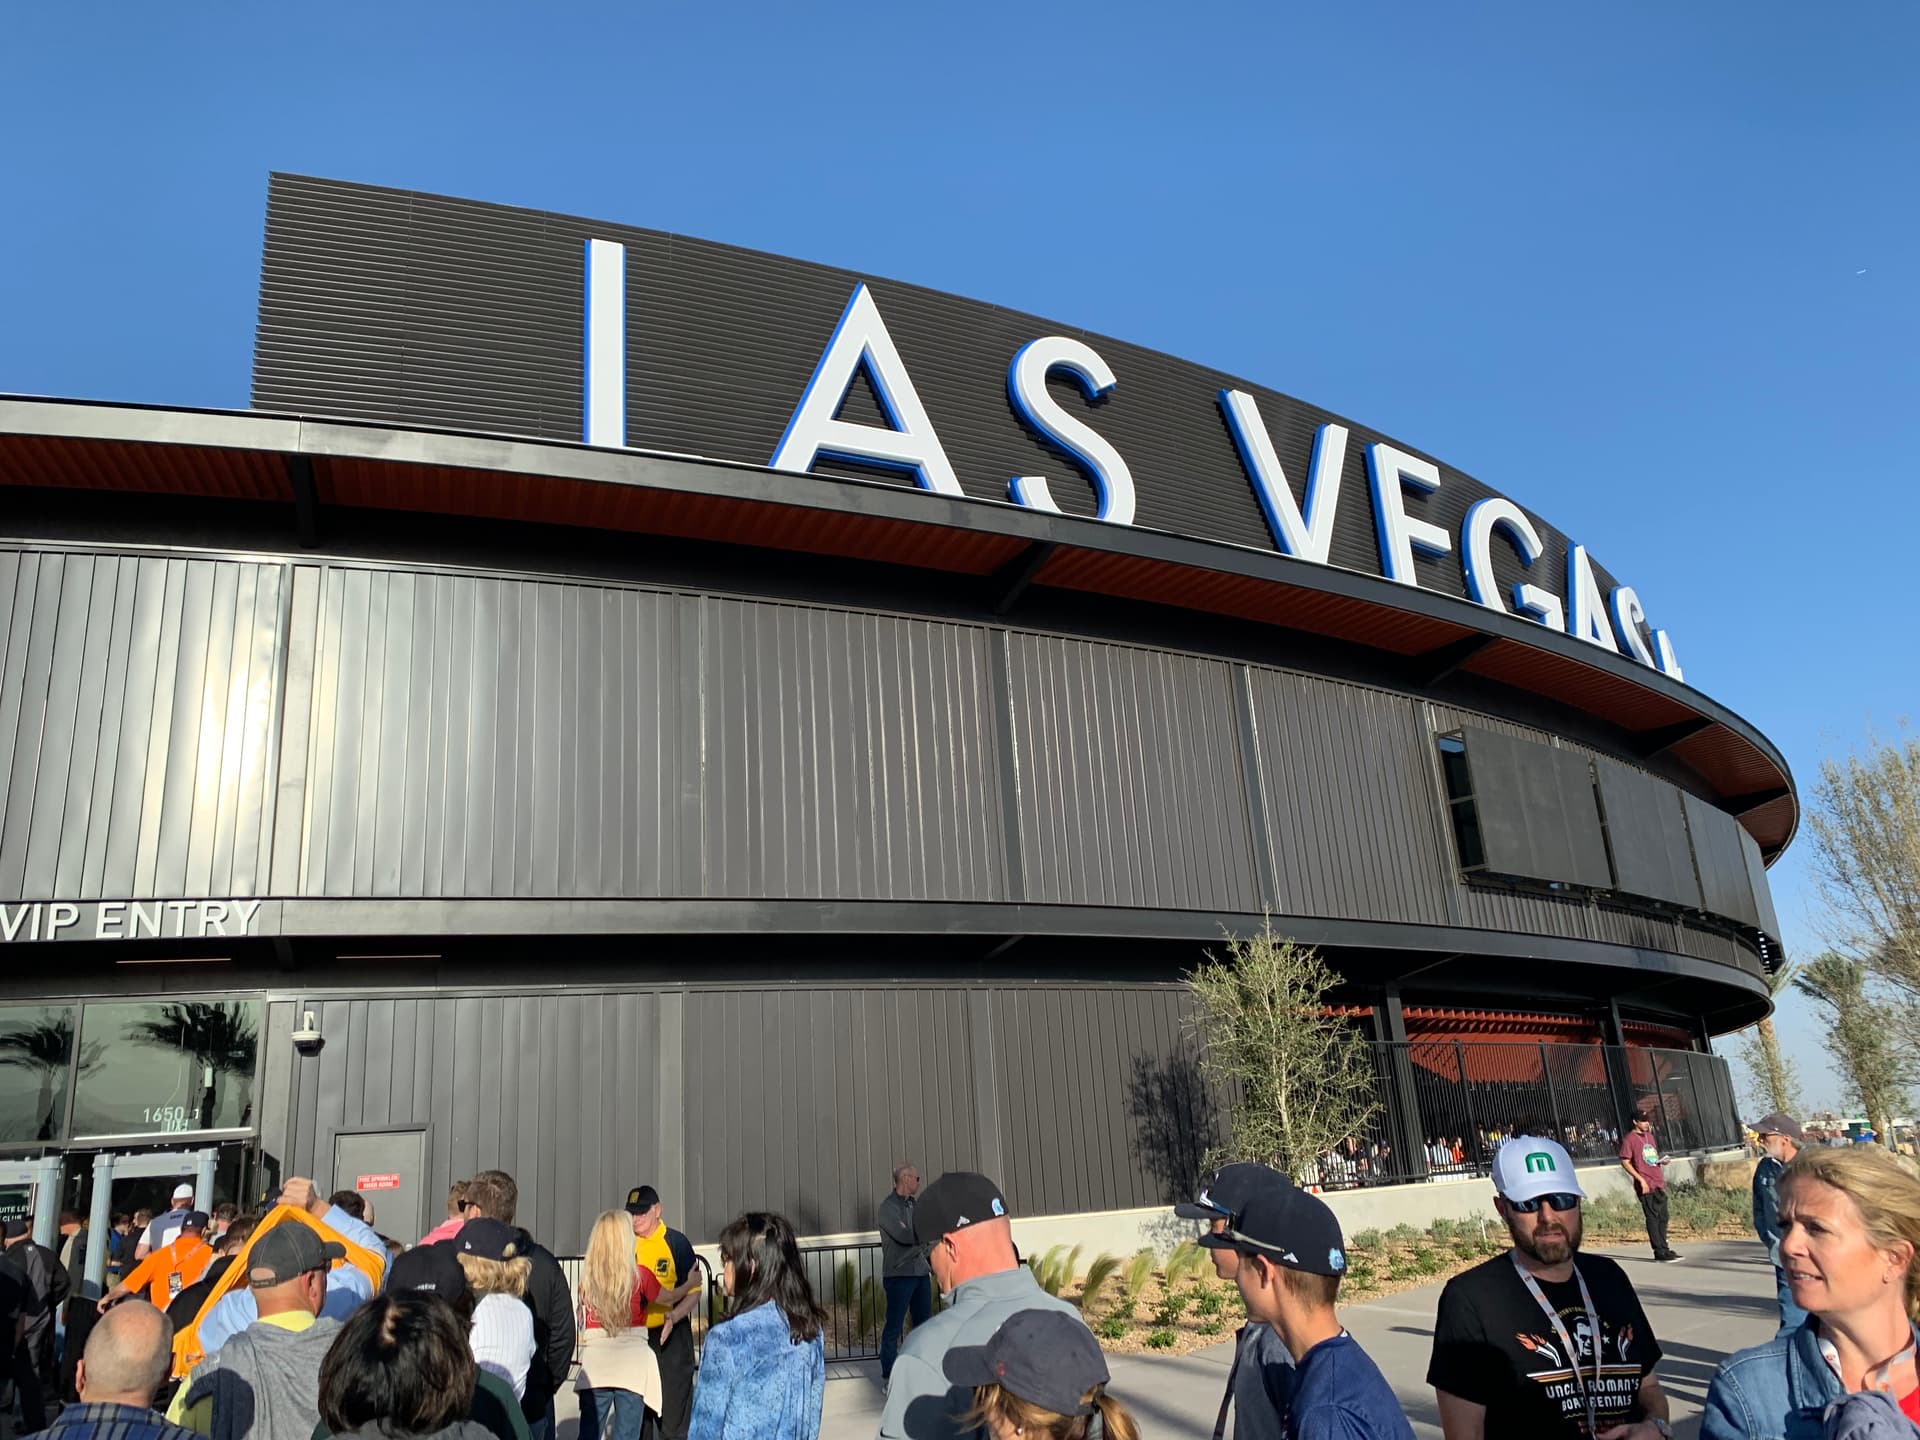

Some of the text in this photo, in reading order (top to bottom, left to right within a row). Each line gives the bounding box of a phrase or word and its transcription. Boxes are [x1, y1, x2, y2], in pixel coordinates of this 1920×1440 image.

[0, 899, 262, 942] VIP ENTRY
[143, 1106, 185, 1123] 1650
